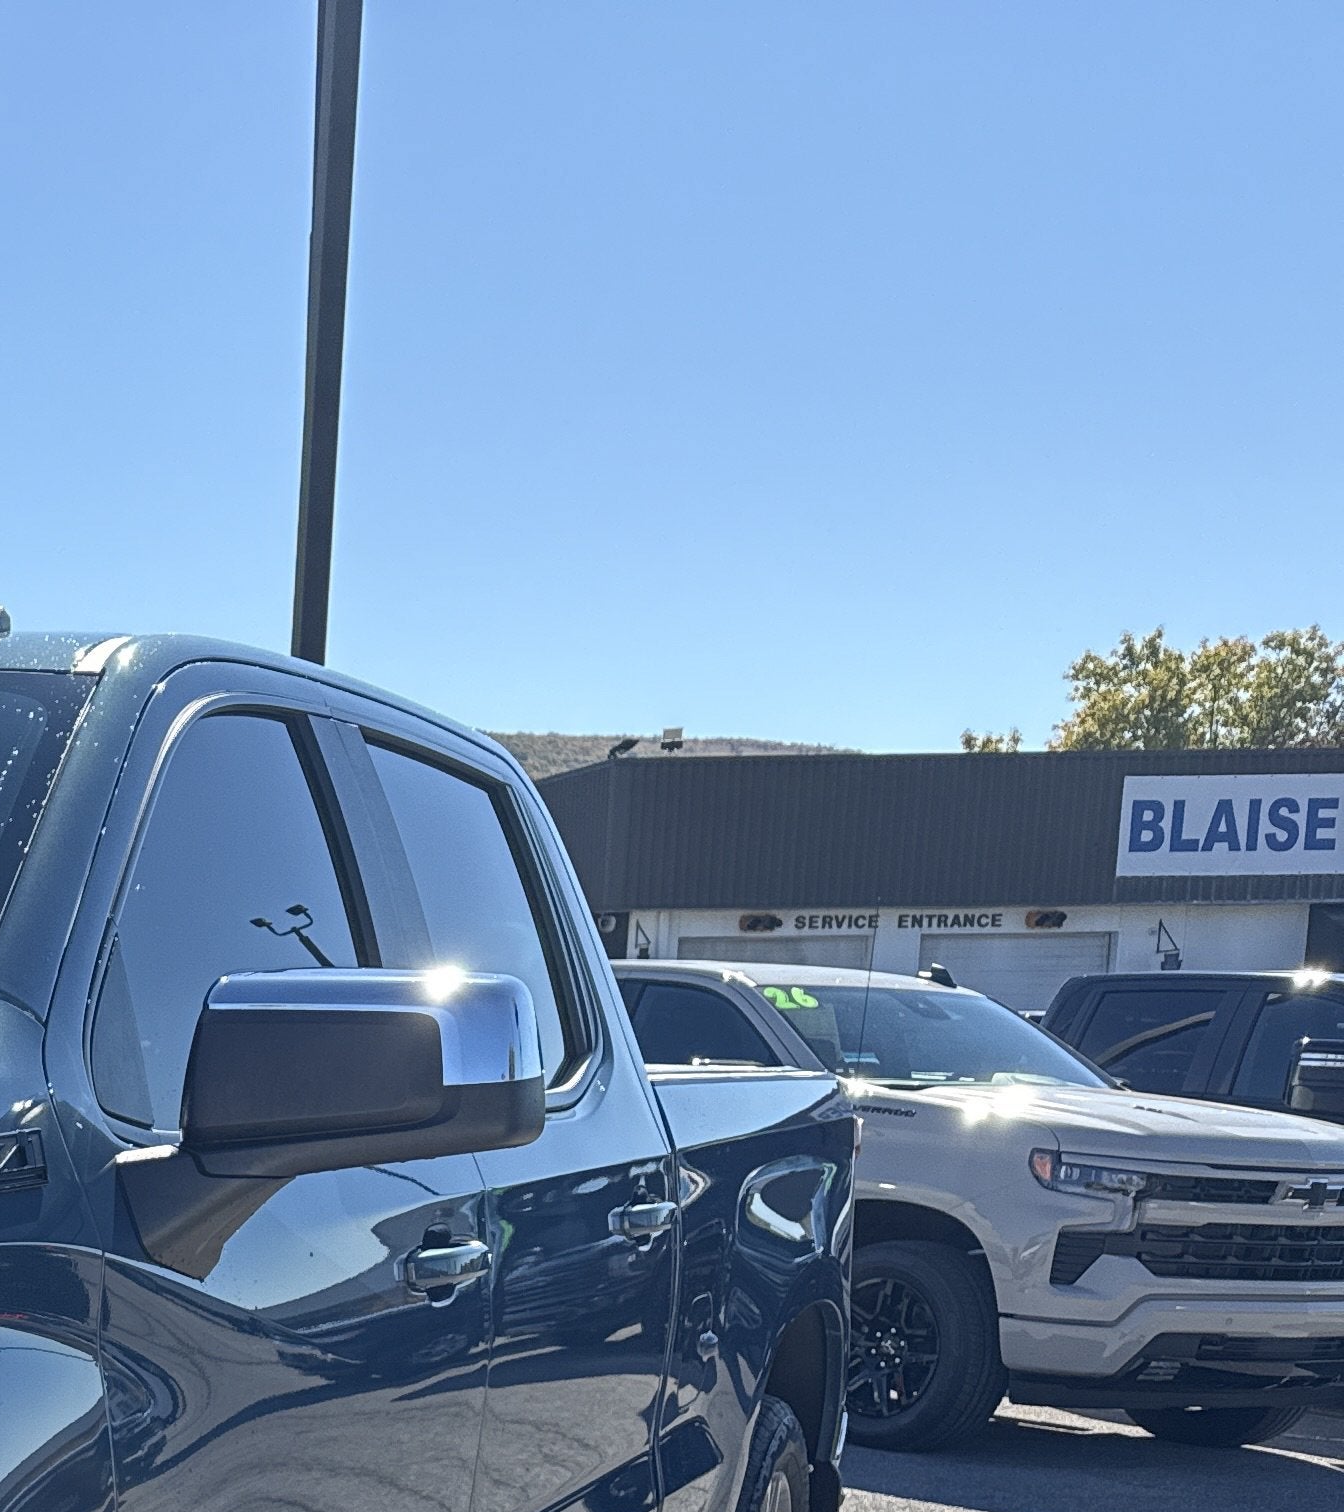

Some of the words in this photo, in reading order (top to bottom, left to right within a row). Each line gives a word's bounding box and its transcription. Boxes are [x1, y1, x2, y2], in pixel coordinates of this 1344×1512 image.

[1128, 797, 1340, 853] BLAISE
[794, 914, 879, 930] SERVICE
[897, 913, 1004, 929] ENTRANCE
[763, 986, 819, 1010] 26
